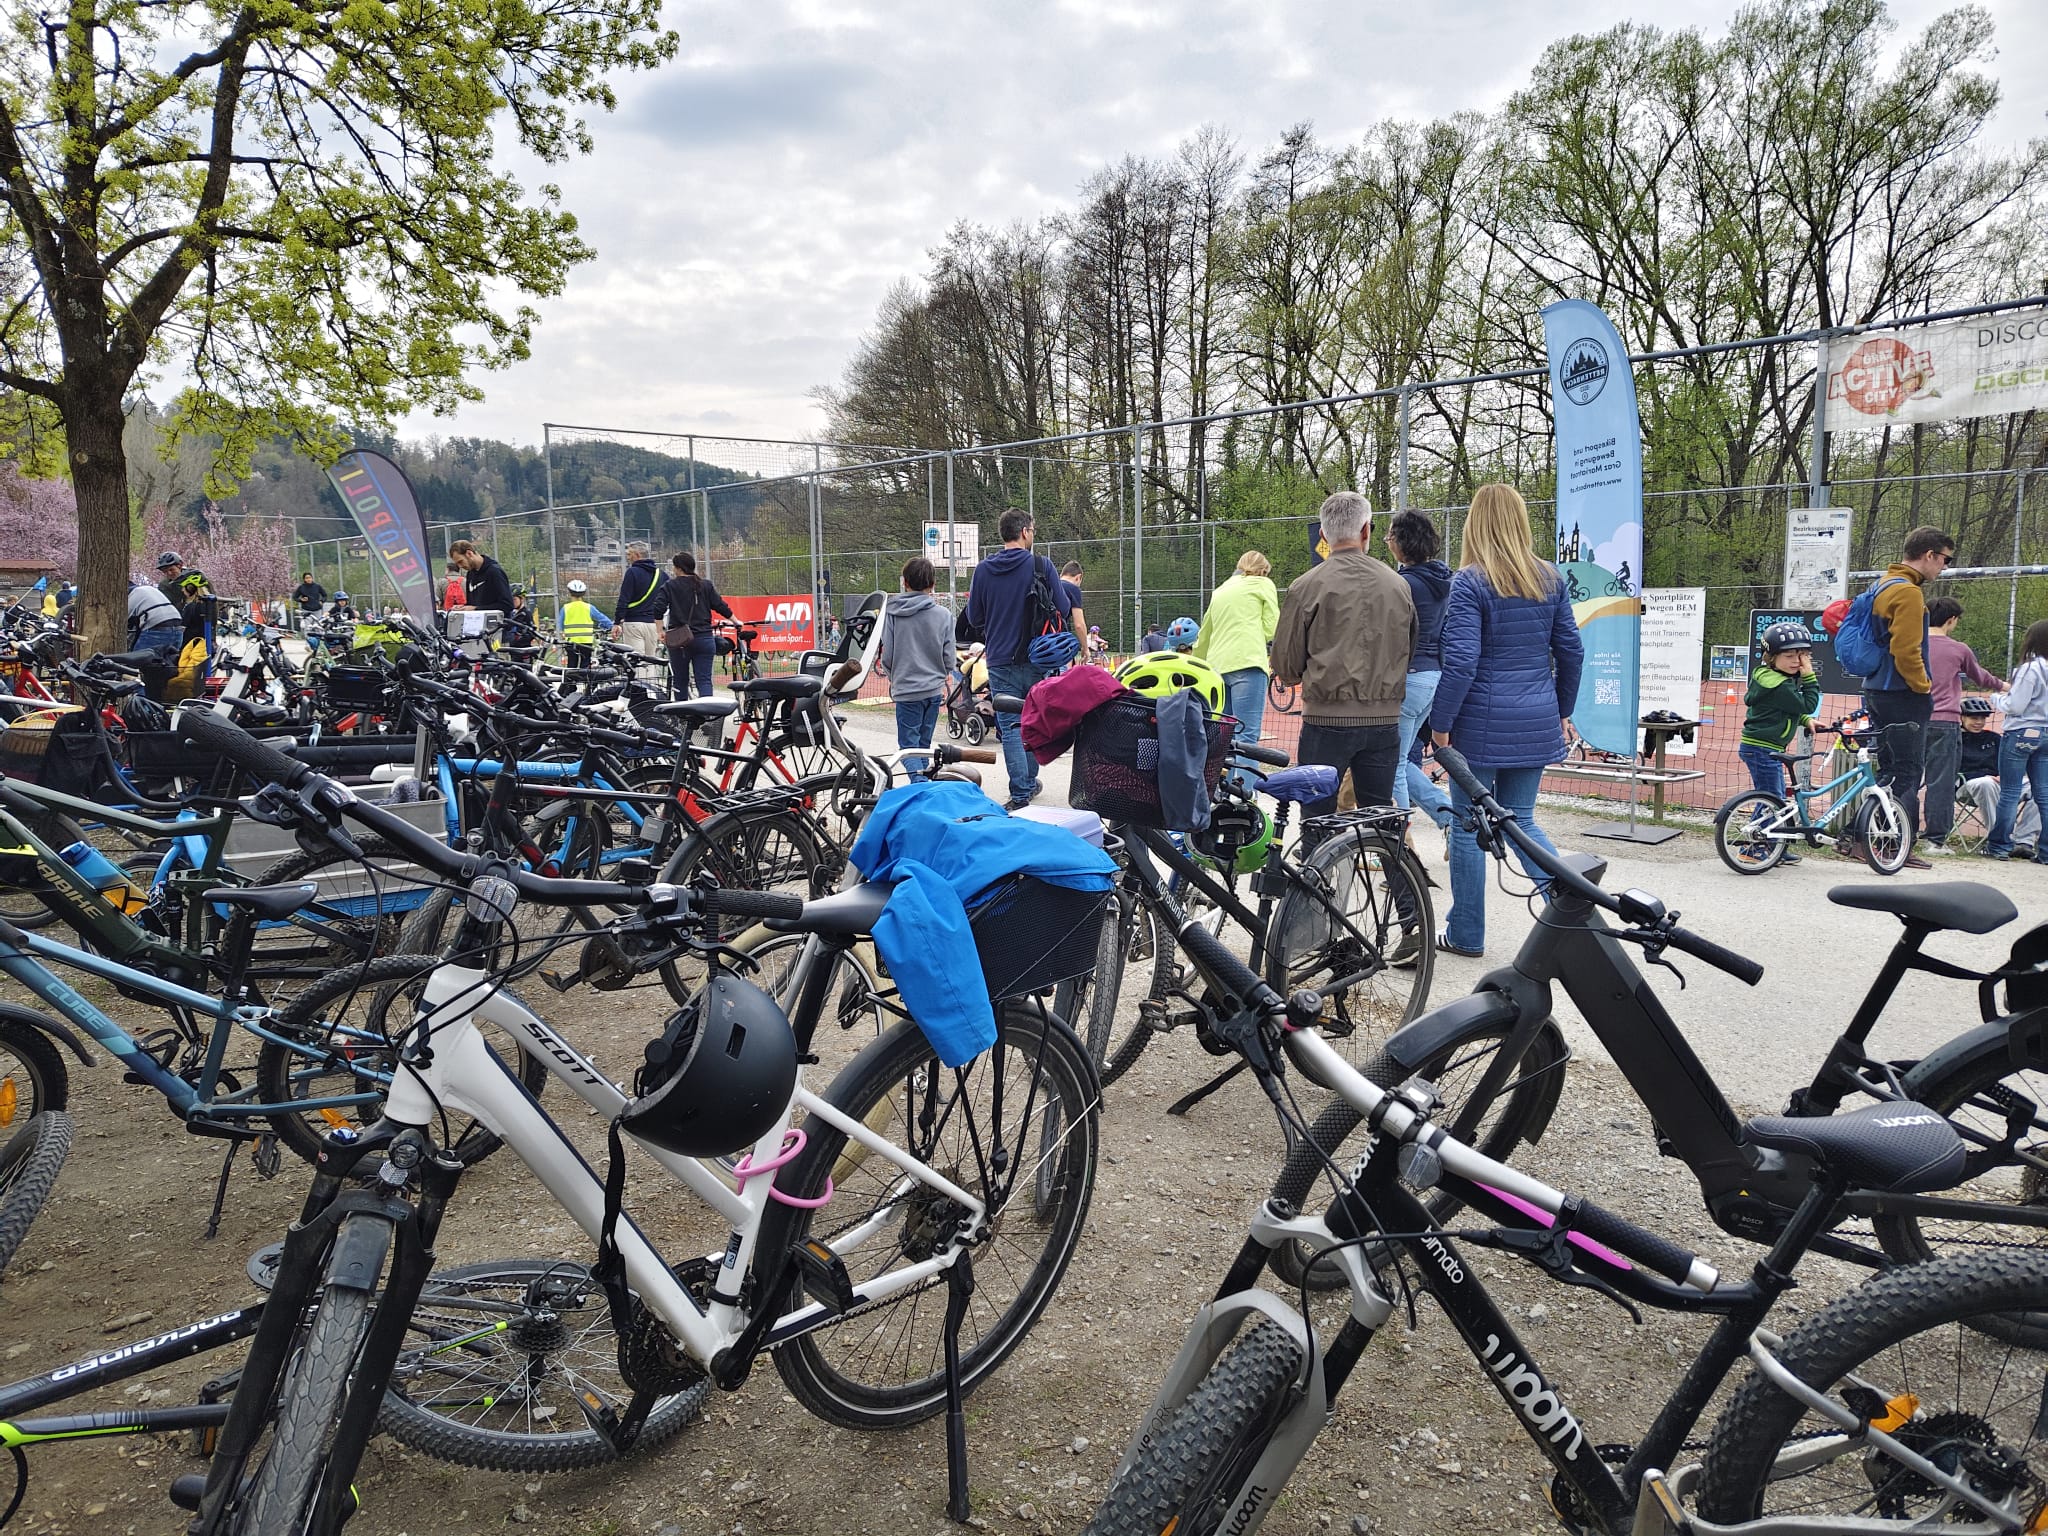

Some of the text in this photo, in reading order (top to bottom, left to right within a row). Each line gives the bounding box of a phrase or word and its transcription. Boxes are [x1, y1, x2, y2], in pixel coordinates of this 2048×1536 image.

[1829, 352, 1934, 398] ACTIVE
[1863, 351, 1894, 365] GRAZ
[1864, 387, 1898, 404] CITY
[1756, 615, 1805, 624] QR-CODE
[46, 982, 107, 1031] CUBE
[521, 1023, 604, 1086] SCOTT
[1870, 1114, 1942, 1128] woom
[51, 1310, 241, 1382] ROCKRIDER
[1481, 1333, 1583, 1461] woom
